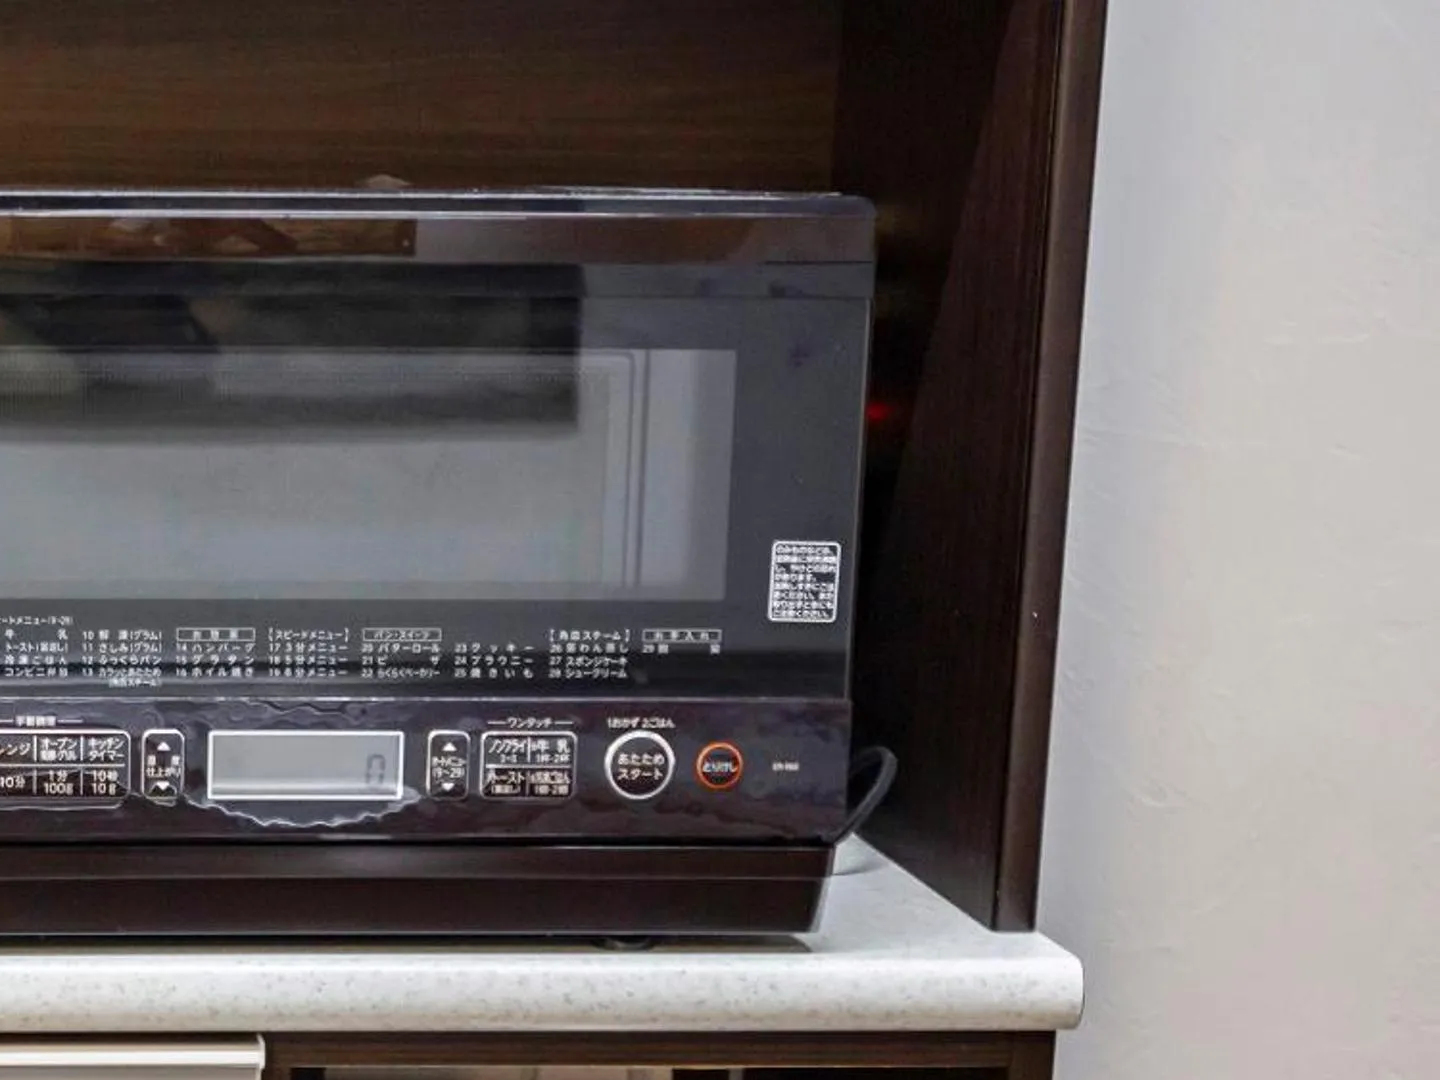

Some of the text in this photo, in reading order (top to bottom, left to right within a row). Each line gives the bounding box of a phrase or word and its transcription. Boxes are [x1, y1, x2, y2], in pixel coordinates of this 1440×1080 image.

[618, 754, 665, 766] あたため
[618, 768, 664, 781] スタート
